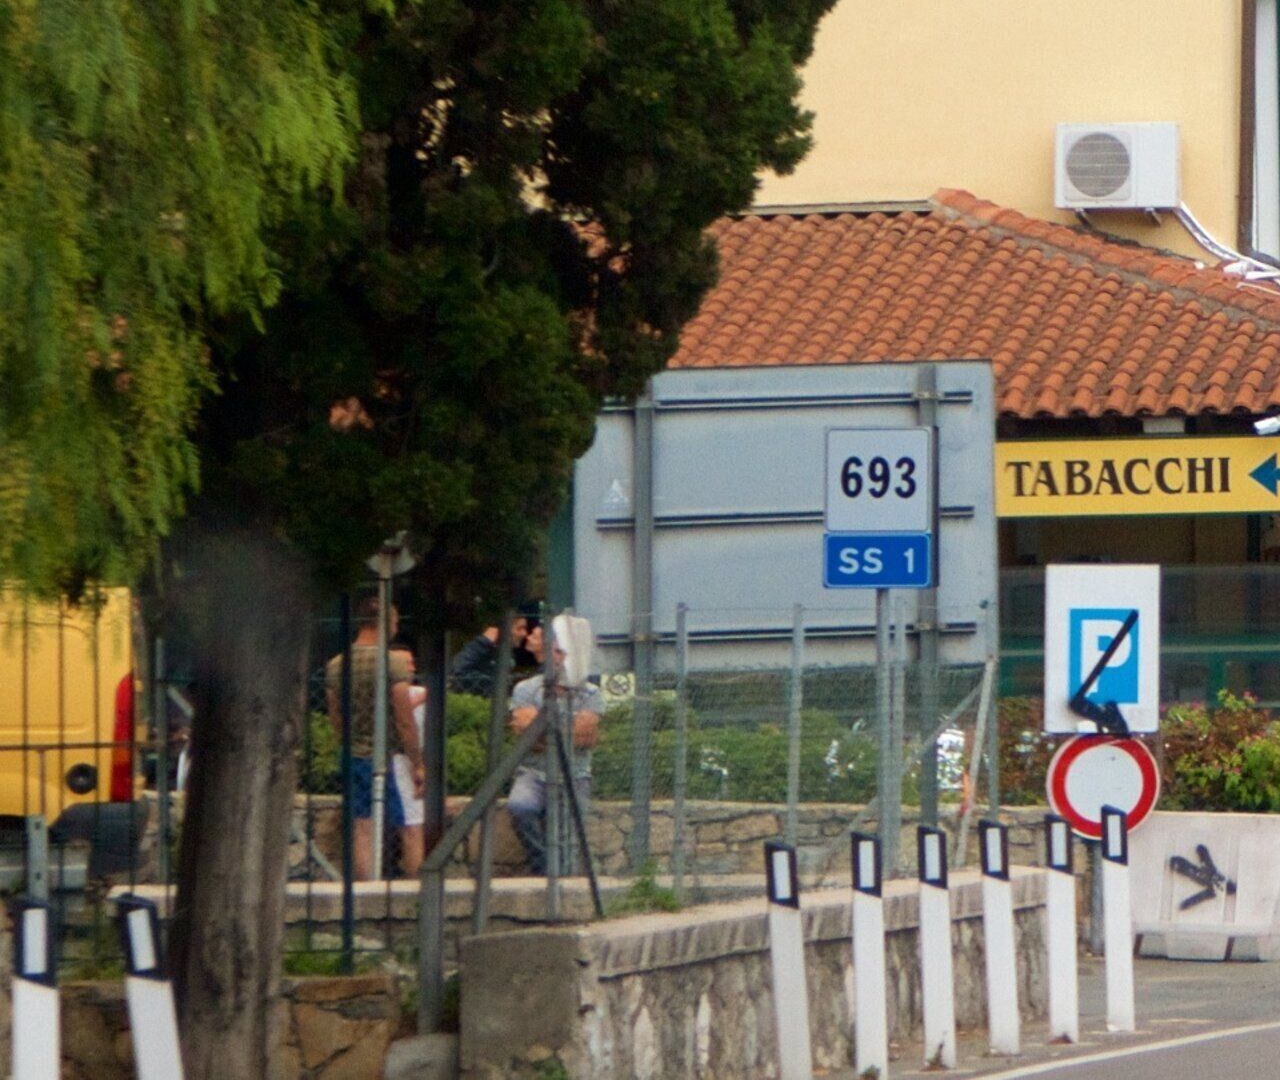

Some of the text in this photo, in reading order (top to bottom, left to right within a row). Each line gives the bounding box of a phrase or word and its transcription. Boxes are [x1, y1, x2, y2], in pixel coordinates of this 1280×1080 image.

[839, 455, 918, 500] 693
[1005, 456, 1232, 497] TABACCHI
[837, 547, 916, 575] SS 1
